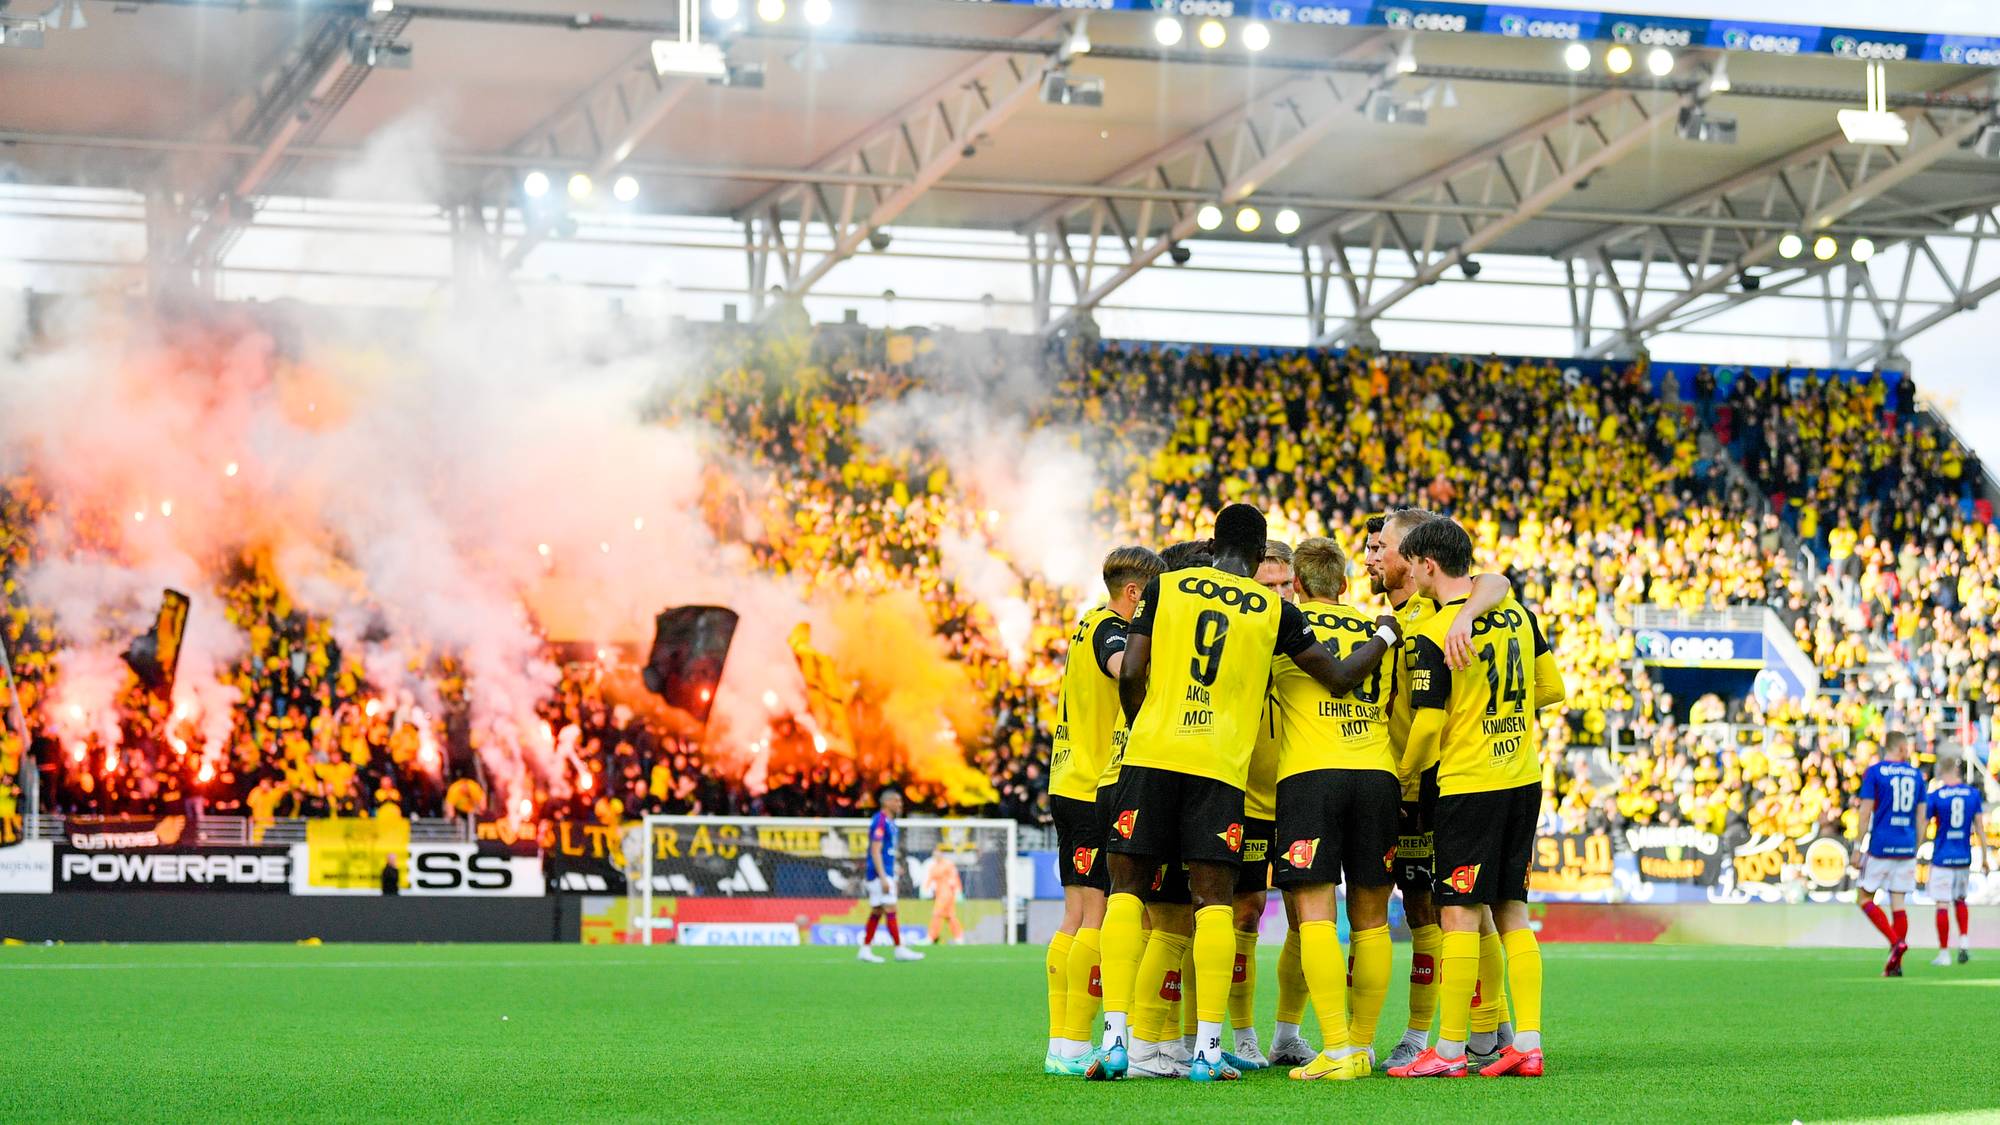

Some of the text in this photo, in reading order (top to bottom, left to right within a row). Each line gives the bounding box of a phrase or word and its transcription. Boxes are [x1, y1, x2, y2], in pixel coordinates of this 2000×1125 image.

[1413, 13, 1467, 32] OBOS
[1528, 20, 1580, 39] OBOS
[1639, 28, 1691, 46] OBOS
[1750, 34, 1800, 53] OBOS
[1857, 41, 1907, 60] OBOS
[1965, 48, 2000, 65] OBO
[1472, 608, 1523, 639] oop
[1190, 609, 1230, 687] 9
[1671, 637, 1734, 660] OBOS
[1478, 637, 1527, 716] 14
[1183, 709, 1213, 726] MOT
[1319, 701, 1353, 718] LEHNE
[1341, 720, 1370, 738] MOT
[1493, 735, 1522, 757] MOT
[1890, 775, 1916, 813] 18
[1950, 797, 1965, 829] 8
[62, 854, 286, 883] POWERADE
[1406, 865, 1415, 880] 5
[707, 931, 794, 946] DAIKIN
